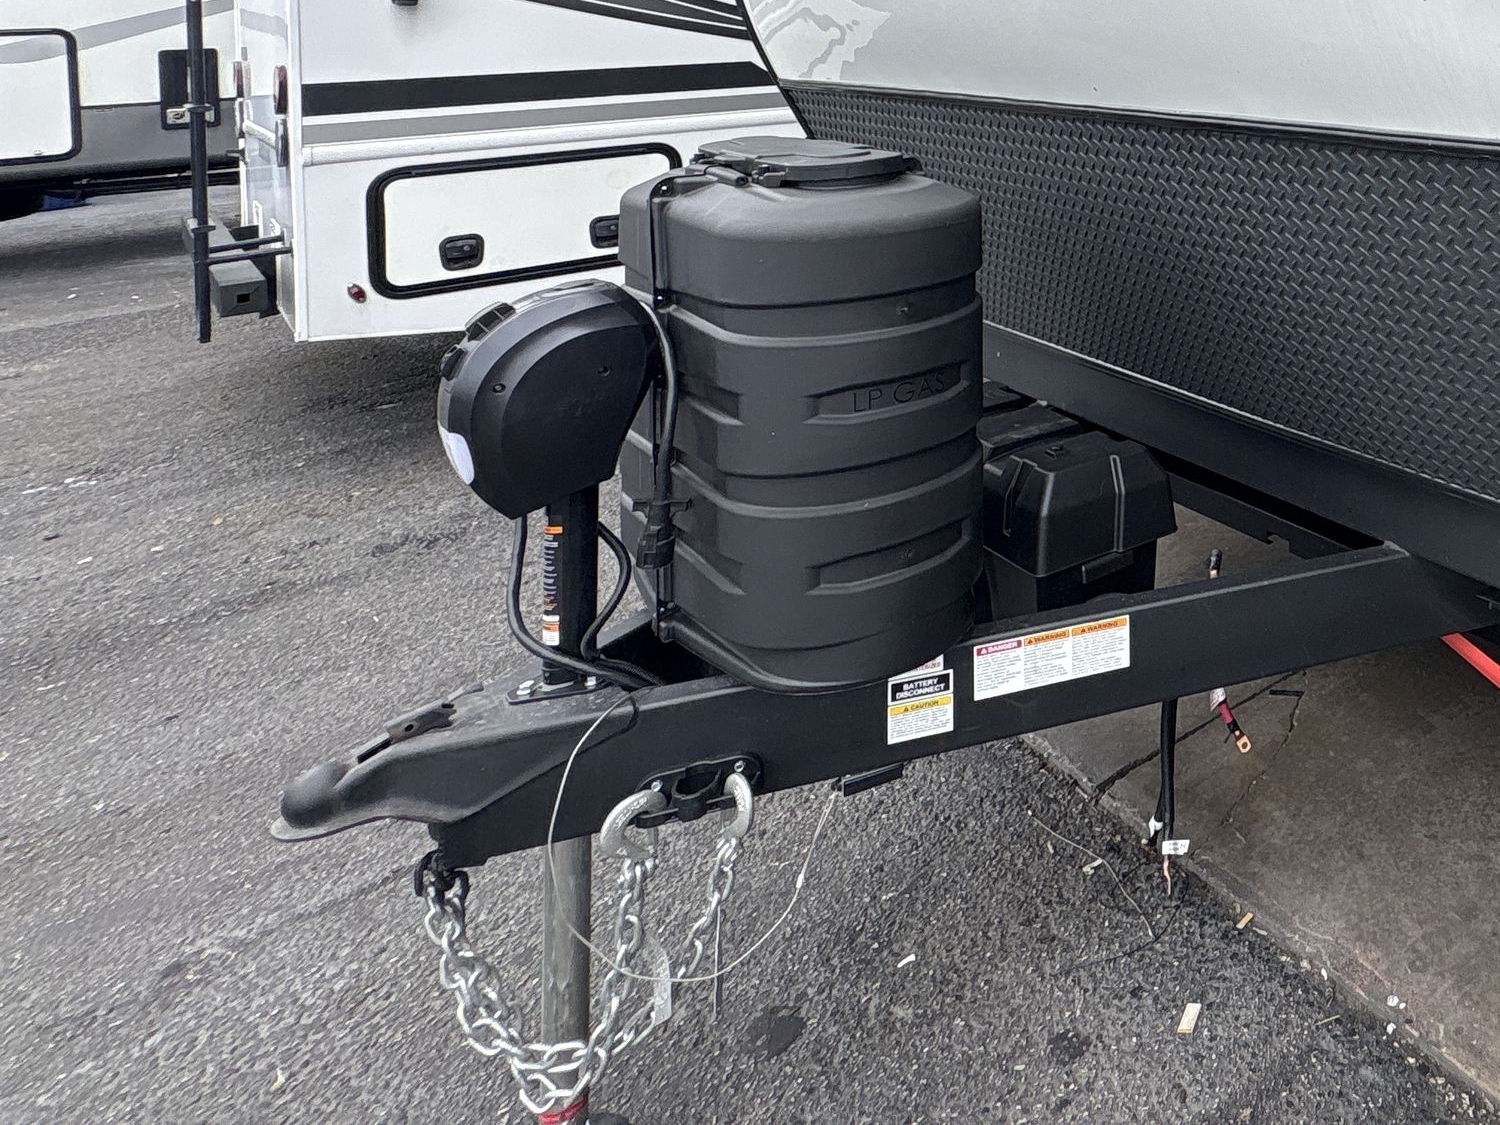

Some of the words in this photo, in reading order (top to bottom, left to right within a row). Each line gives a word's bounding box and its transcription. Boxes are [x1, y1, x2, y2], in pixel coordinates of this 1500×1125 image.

[853, 387, 883, 413] LP
[893, 372, 945, 403] GAS
[1087, 621, 1118, 632] WARNING
[1034, 631, 1066, 644] WARNING
[988, 640, 1018, 654] DANGER
[902, 677, 939, 691] BATTERY
[895, 683, 946, 700] DISCONNECT
[910, 699, 939, 712] CAUTION
